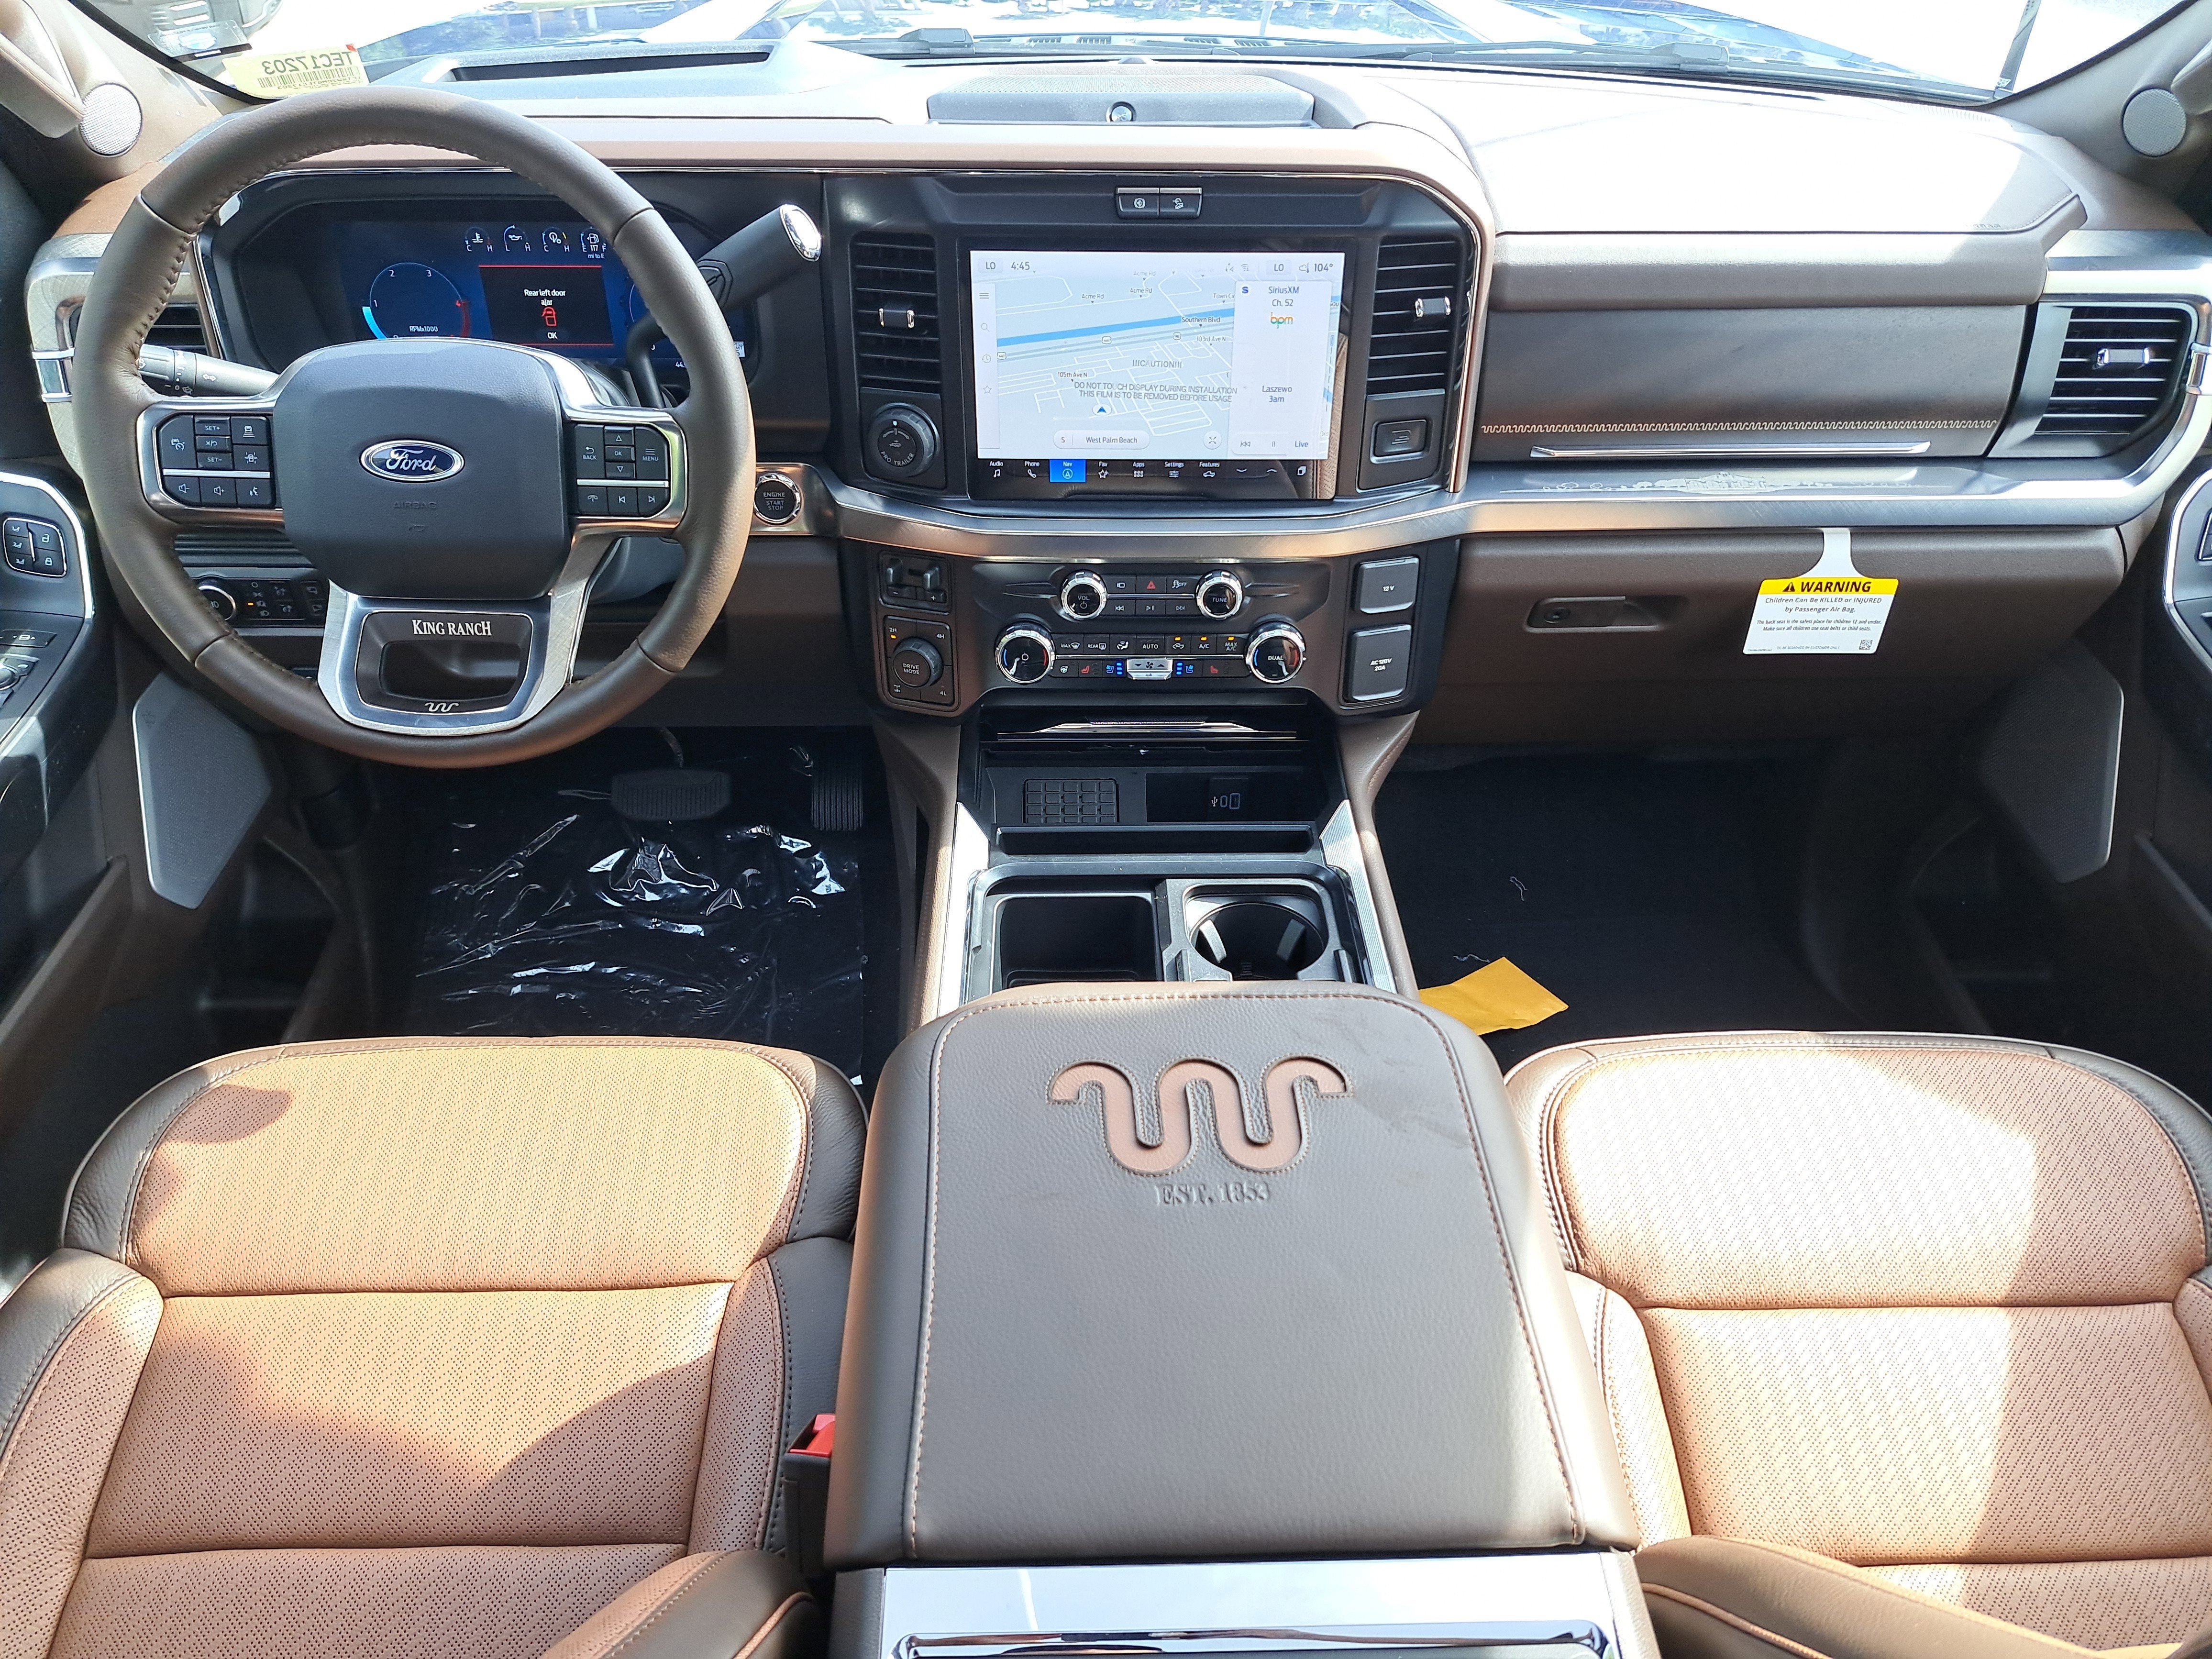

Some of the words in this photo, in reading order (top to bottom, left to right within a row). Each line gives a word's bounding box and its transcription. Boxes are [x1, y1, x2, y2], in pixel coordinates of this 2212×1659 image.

[985, 262, 996, 270] LO
[1011, 261, 1030, 270] 4:45
[1274, 264, 1284, 272] LO
[1314, 263, 1333, 272] 104°
[1268, 286, 1299, 294] SiriusXM
[1272, 299, 1283, 307] Ch.
[1271, 312, 1294, 329] bpm
[1188, 386, 1238, 394] INSTALLATION
[386, 448, 437, 471] Ford
[881, 451, 892, 463] PRO
[894, 453, 915, 466] TRAILER
[1801, 581, 1872, 593] WARNING
[412, 619, 445, 635] KING
[448, 621, 492, 636] RANCH
[1217, 1181, 1271, 1204] 1853
